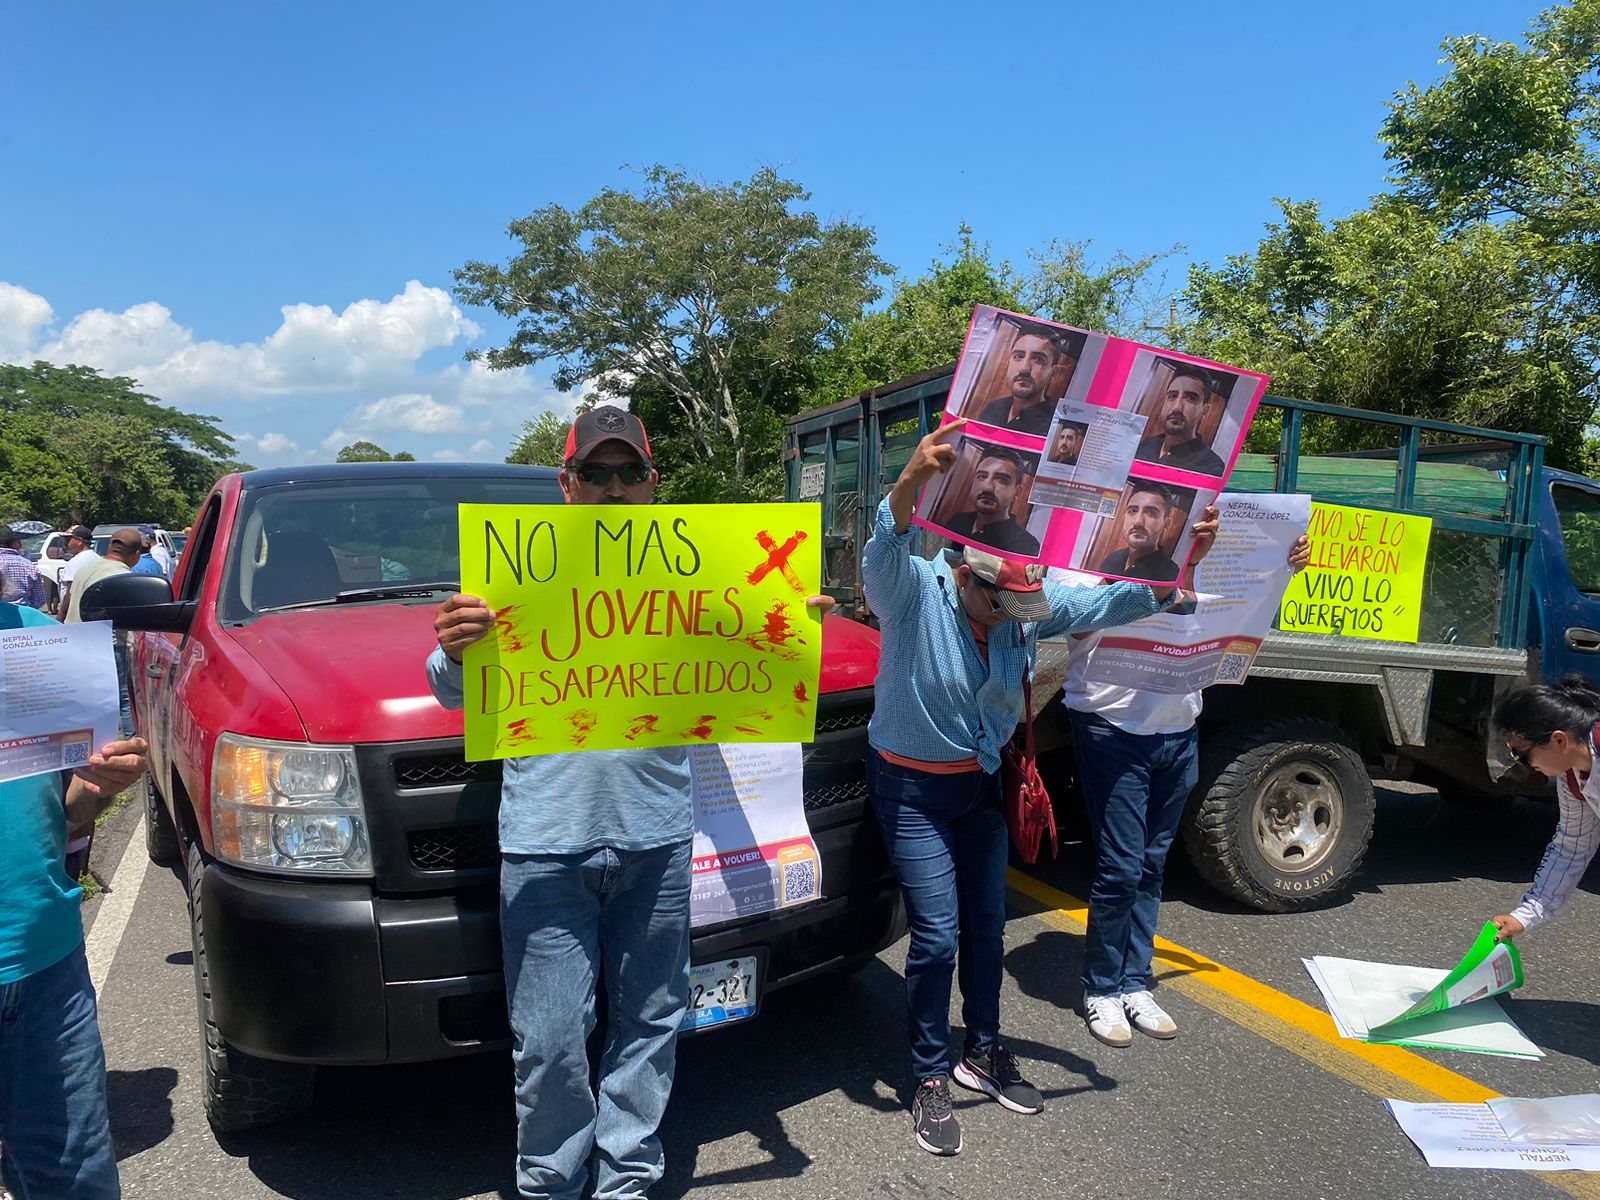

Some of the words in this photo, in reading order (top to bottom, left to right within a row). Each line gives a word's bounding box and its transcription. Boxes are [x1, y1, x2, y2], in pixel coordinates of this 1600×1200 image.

[1227, 502, 1259, 510] NEPTALI
[1266, 511, 1291, 520] LÓPEZ
[1348, 512, 1372, 542] SE
[1380, 517, 1406, 547] LO
[485, 518, 558, 586] NO
[594, 517, 701, 577] MAS
[1308, 540, 1400, 575] LLEVARON
[1304, 572, 1354, 602] VIVO
[1363, 576, 1392, 603] LO
[540, 586, 744, 662] JOVENES
[2, 635, 32, 643] NEPTALI
[3, 640, 42, 650] GONZÁLEZ
[44, 638, 68, 646] LÓPEZ
[1095, 658, 1135, 670] CONTACTO
[480, 659, 773, 715] DESAPARECIDOS
[713, 859, 721, 868] A
[724, 851, 760, 866] VOLVER!
[1274, 866, 1334, 891] AUSTONE
[1520, 1152, 1571, 1162] NEPTALI
